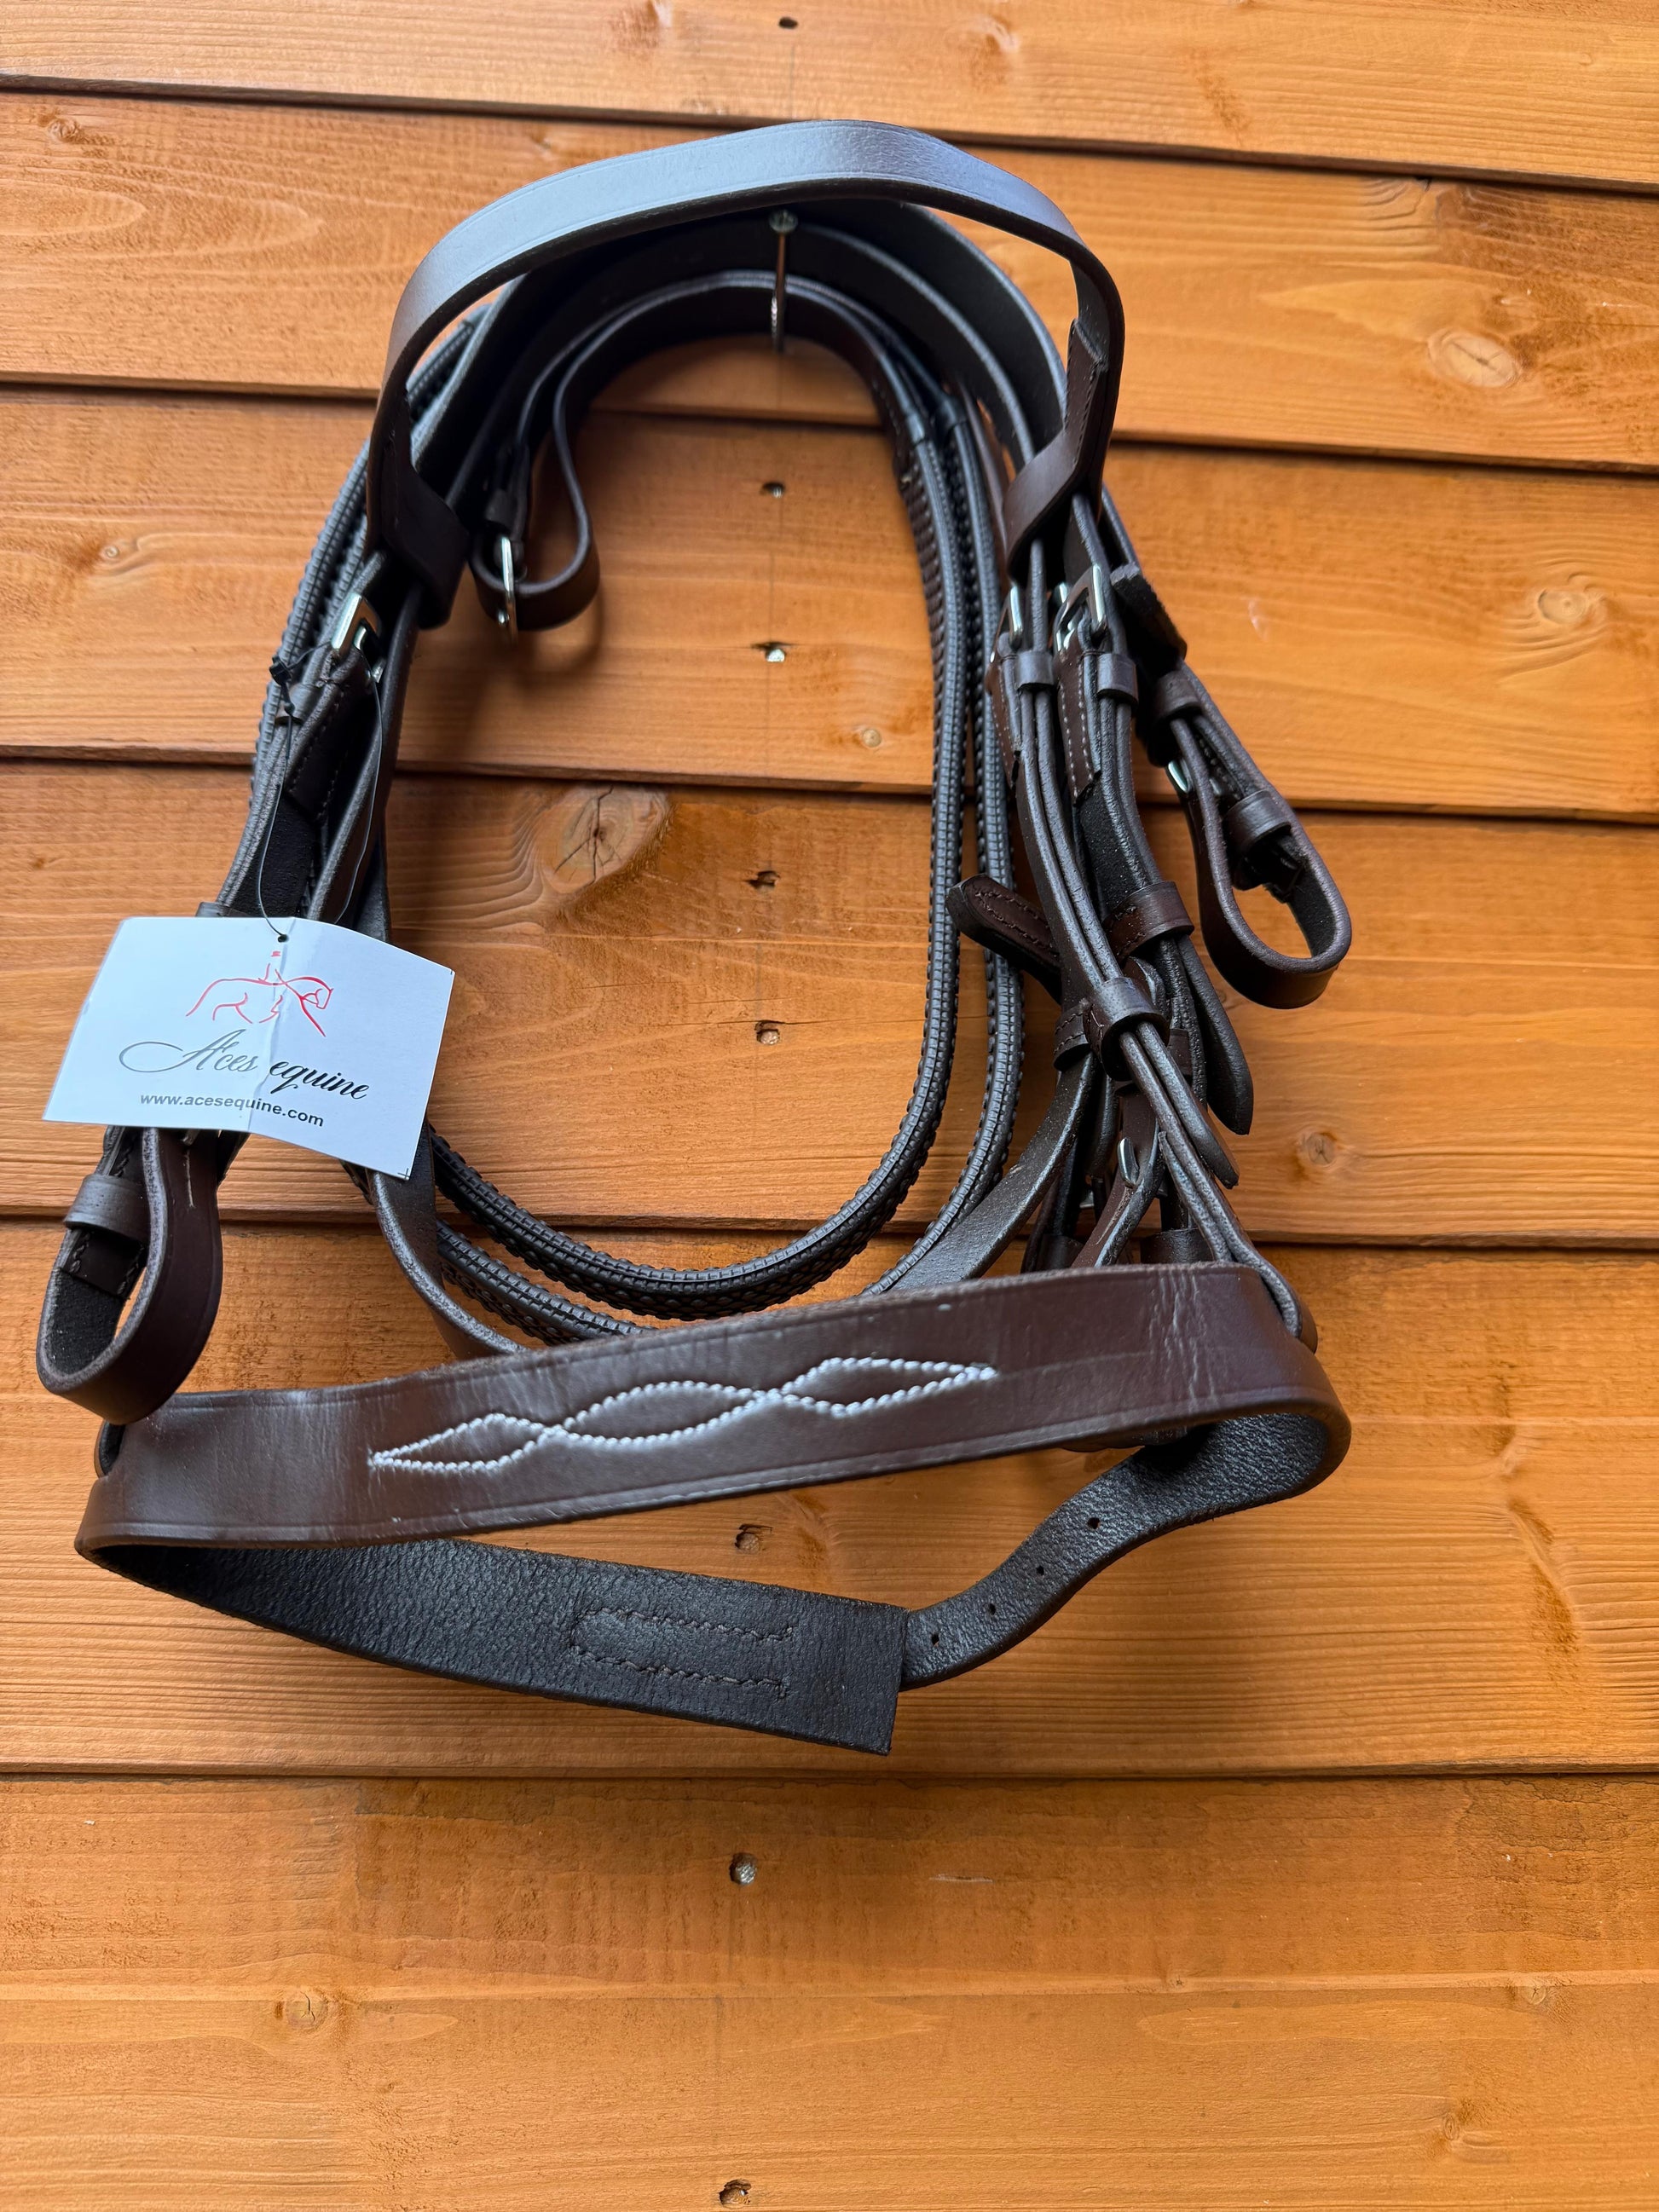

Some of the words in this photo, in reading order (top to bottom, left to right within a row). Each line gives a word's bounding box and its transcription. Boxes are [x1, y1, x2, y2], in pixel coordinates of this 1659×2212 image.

[118, 1029, 258, 1073] Aces
[269, 1060, 372, 1100] equine
[140, 1092, 324, 1127] www.acesequine.com
